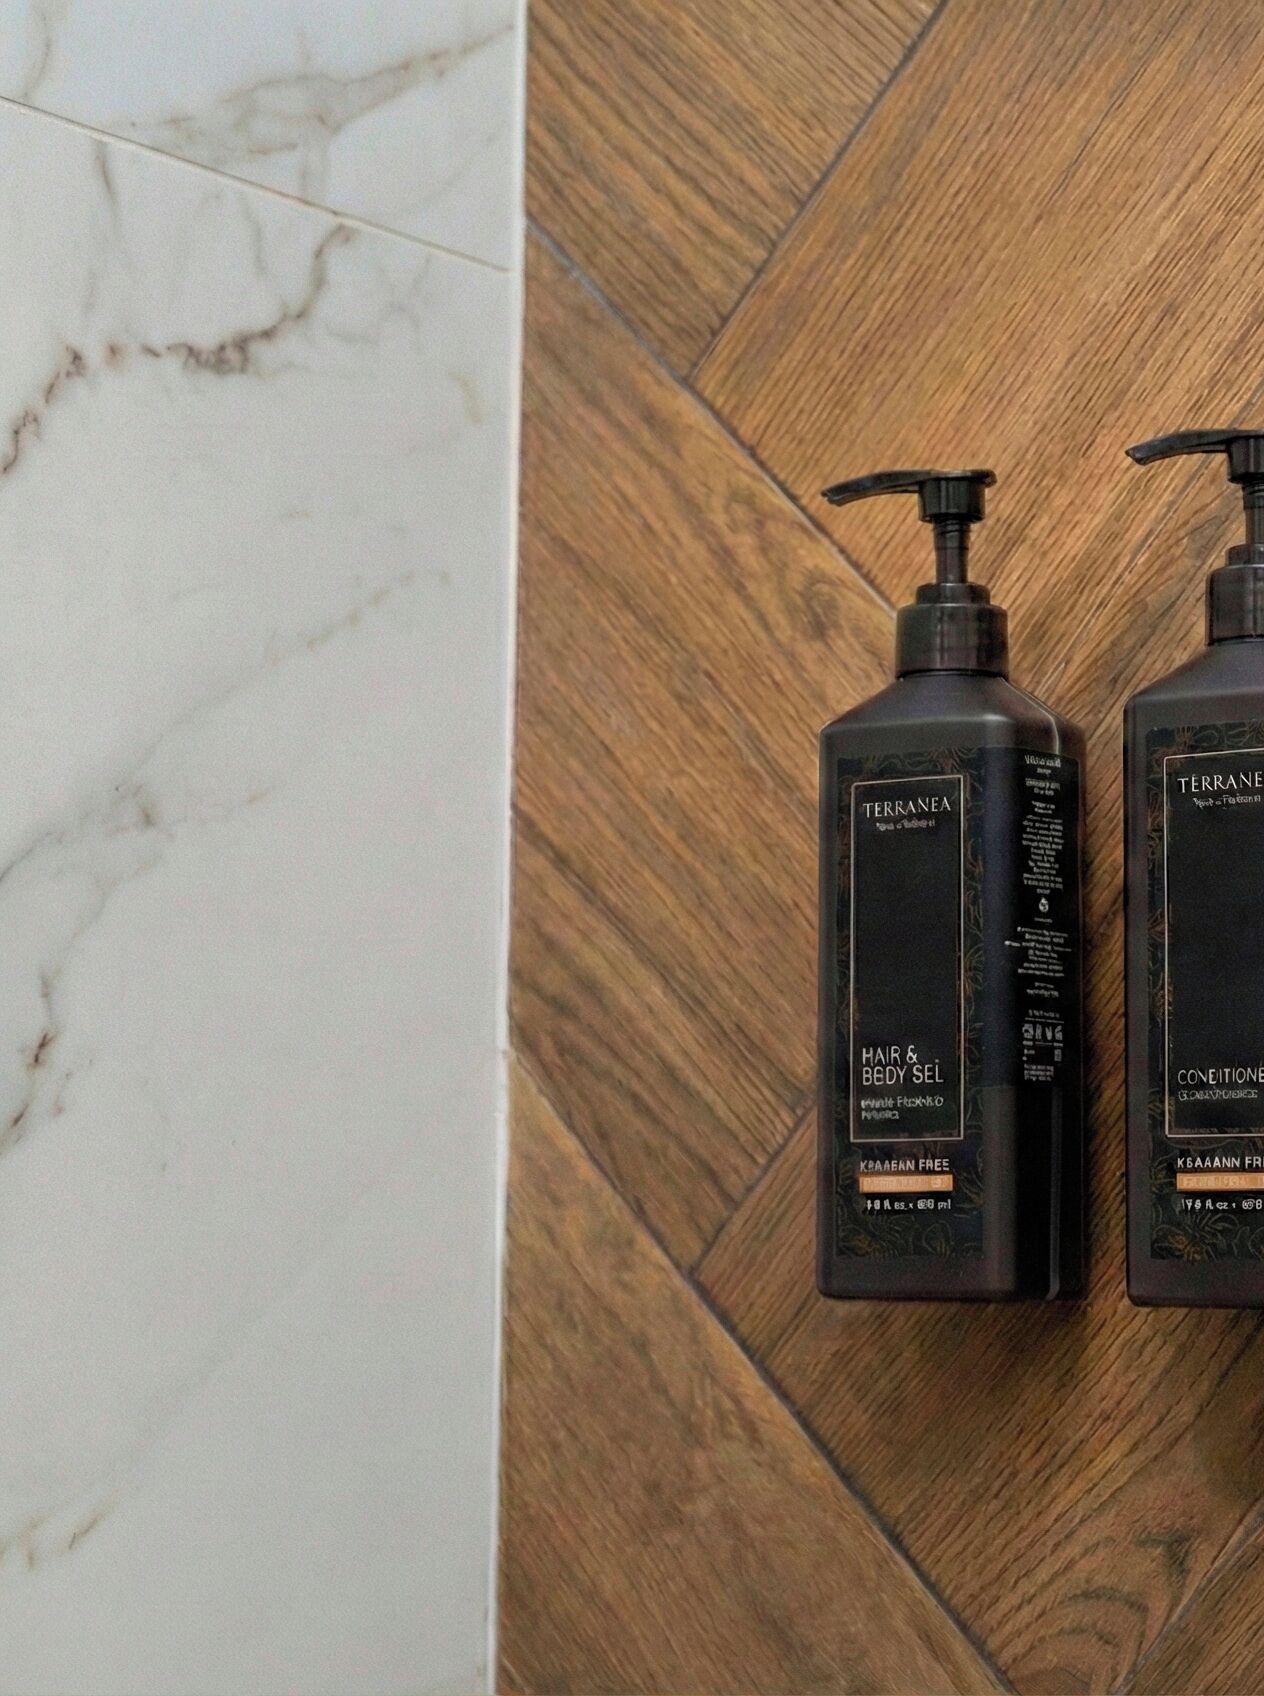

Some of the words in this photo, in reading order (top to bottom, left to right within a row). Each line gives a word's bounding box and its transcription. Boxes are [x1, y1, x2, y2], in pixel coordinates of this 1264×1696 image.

[863, 796, 951, 818] TERRANEA
[862, 1046, 901, 1066] HAIR
[906, 1045, 918, 1063] &
